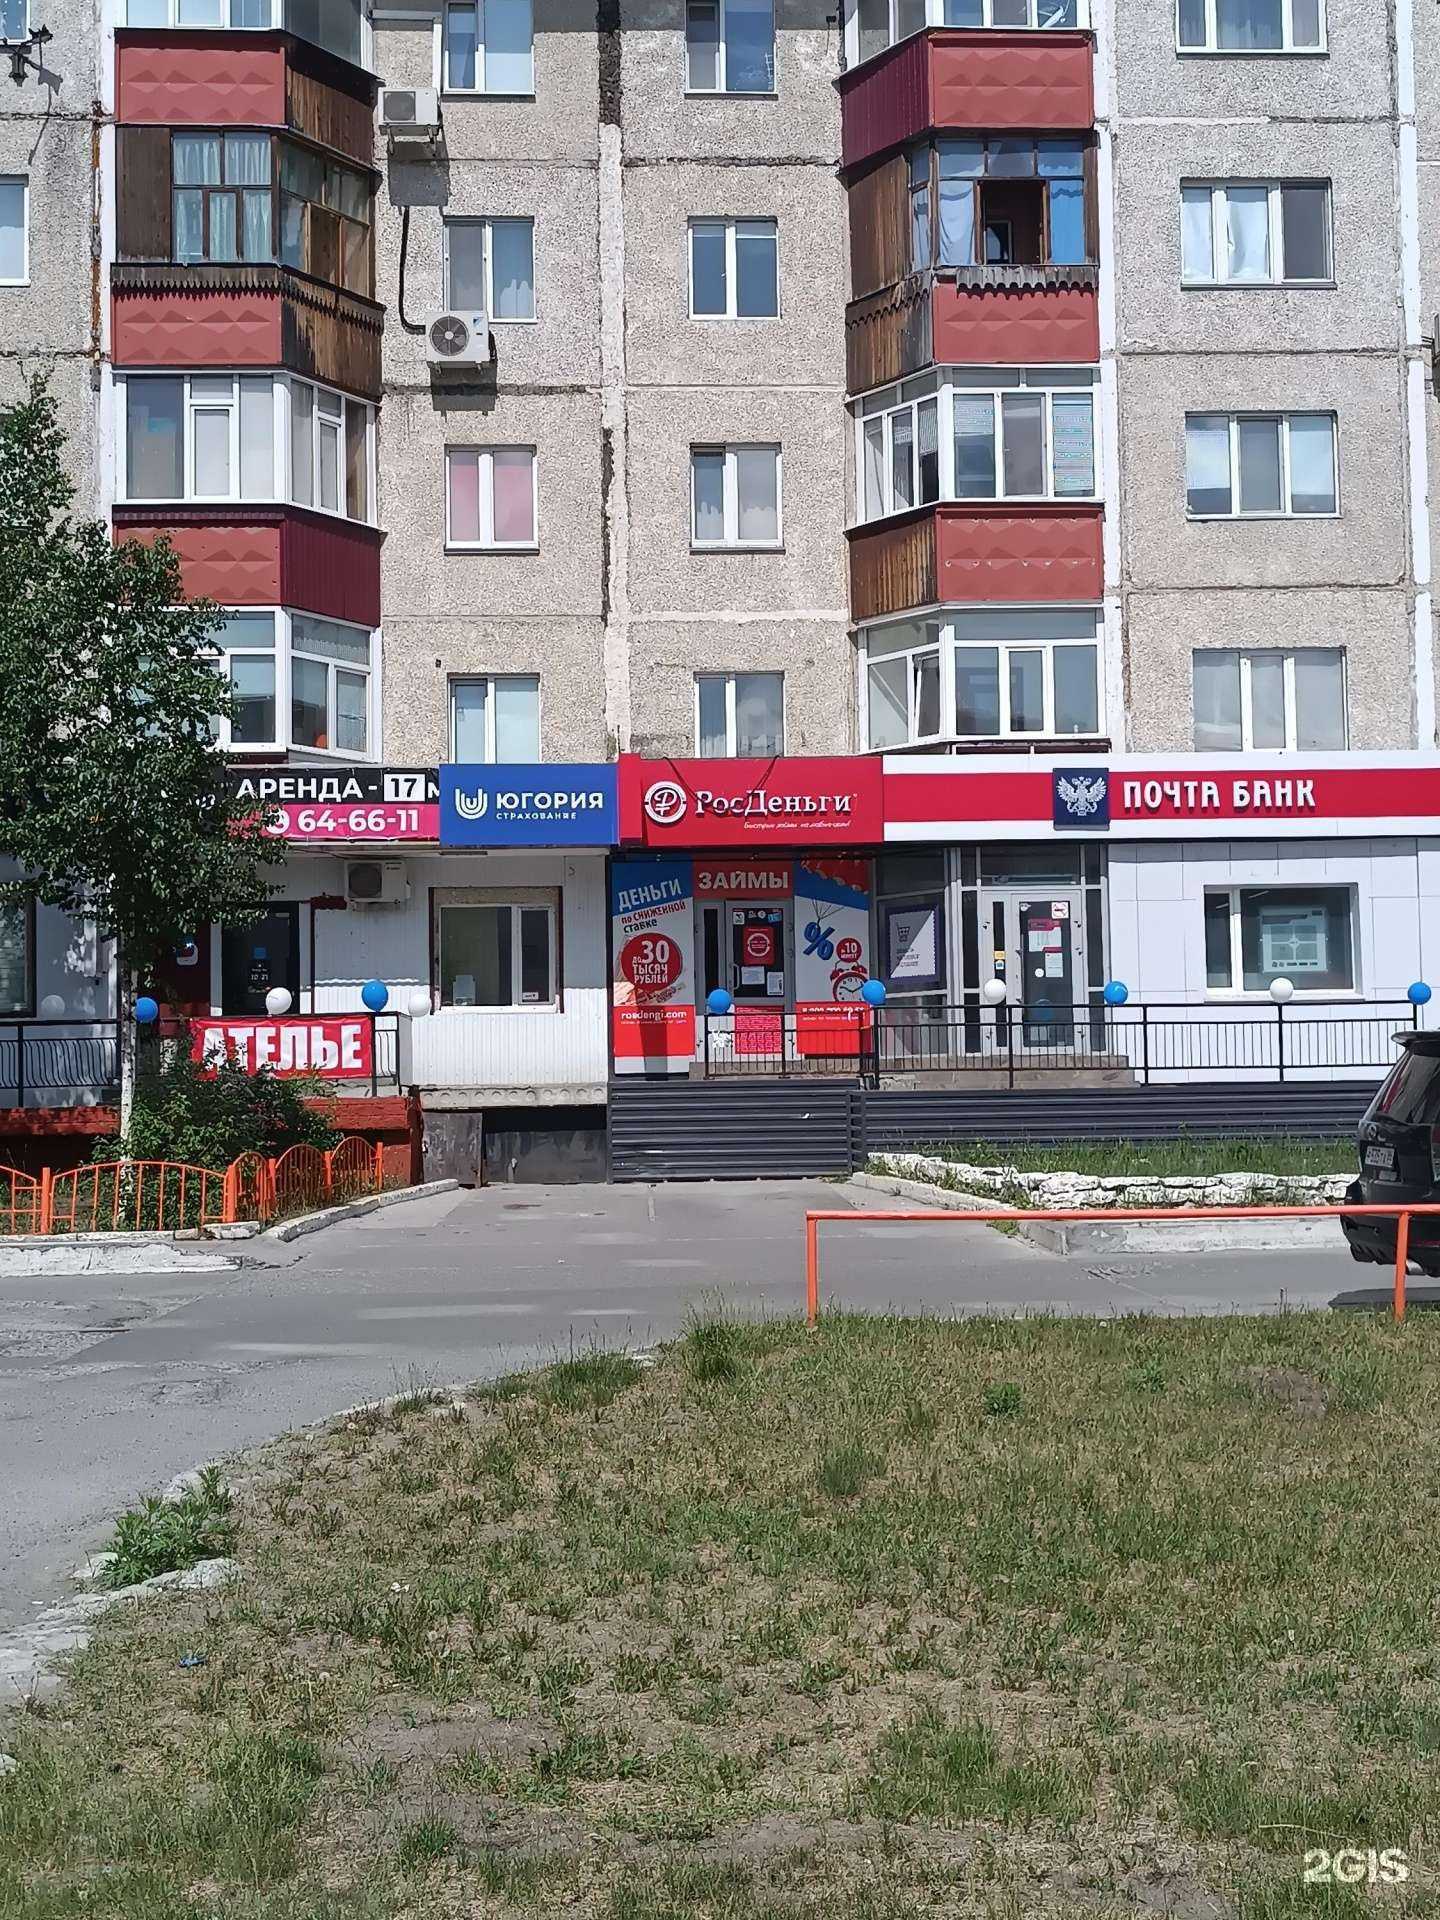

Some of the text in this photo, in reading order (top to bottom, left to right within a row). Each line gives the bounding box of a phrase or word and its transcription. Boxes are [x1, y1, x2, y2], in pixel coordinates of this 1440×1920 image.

[236, 777, 364, 802] АРЕНДА
[390, 778, 418, 798] 17
[1123, 779, 1316, 809] ПОЧТА БАНК
[496, 792, 603, 809] ЮГОРИЯ
[694, 790, 852, 816] РосДеньги
[297, 808, 419, 832] 64-66-11
[496, 811, 577, 820] СТРАХОВАНИЕ
[698, 871, 789, 889] ЗАЙМЫ
[618, 878, 682, 912] ДЕНЬГИ
[623, 919, 658, 934] ставке
[641, 940, 670, 964] 30
[845, 942, 858, 954] 10
[632, 963, 668, 975] ТЫСЯЧ
[634, 974, 668, 984] РУБЛЕЙ
[621, 1010, 687, 1021] rosdengi.com
[202, 1024, 363, 1073] АТЕЛЬЕ
